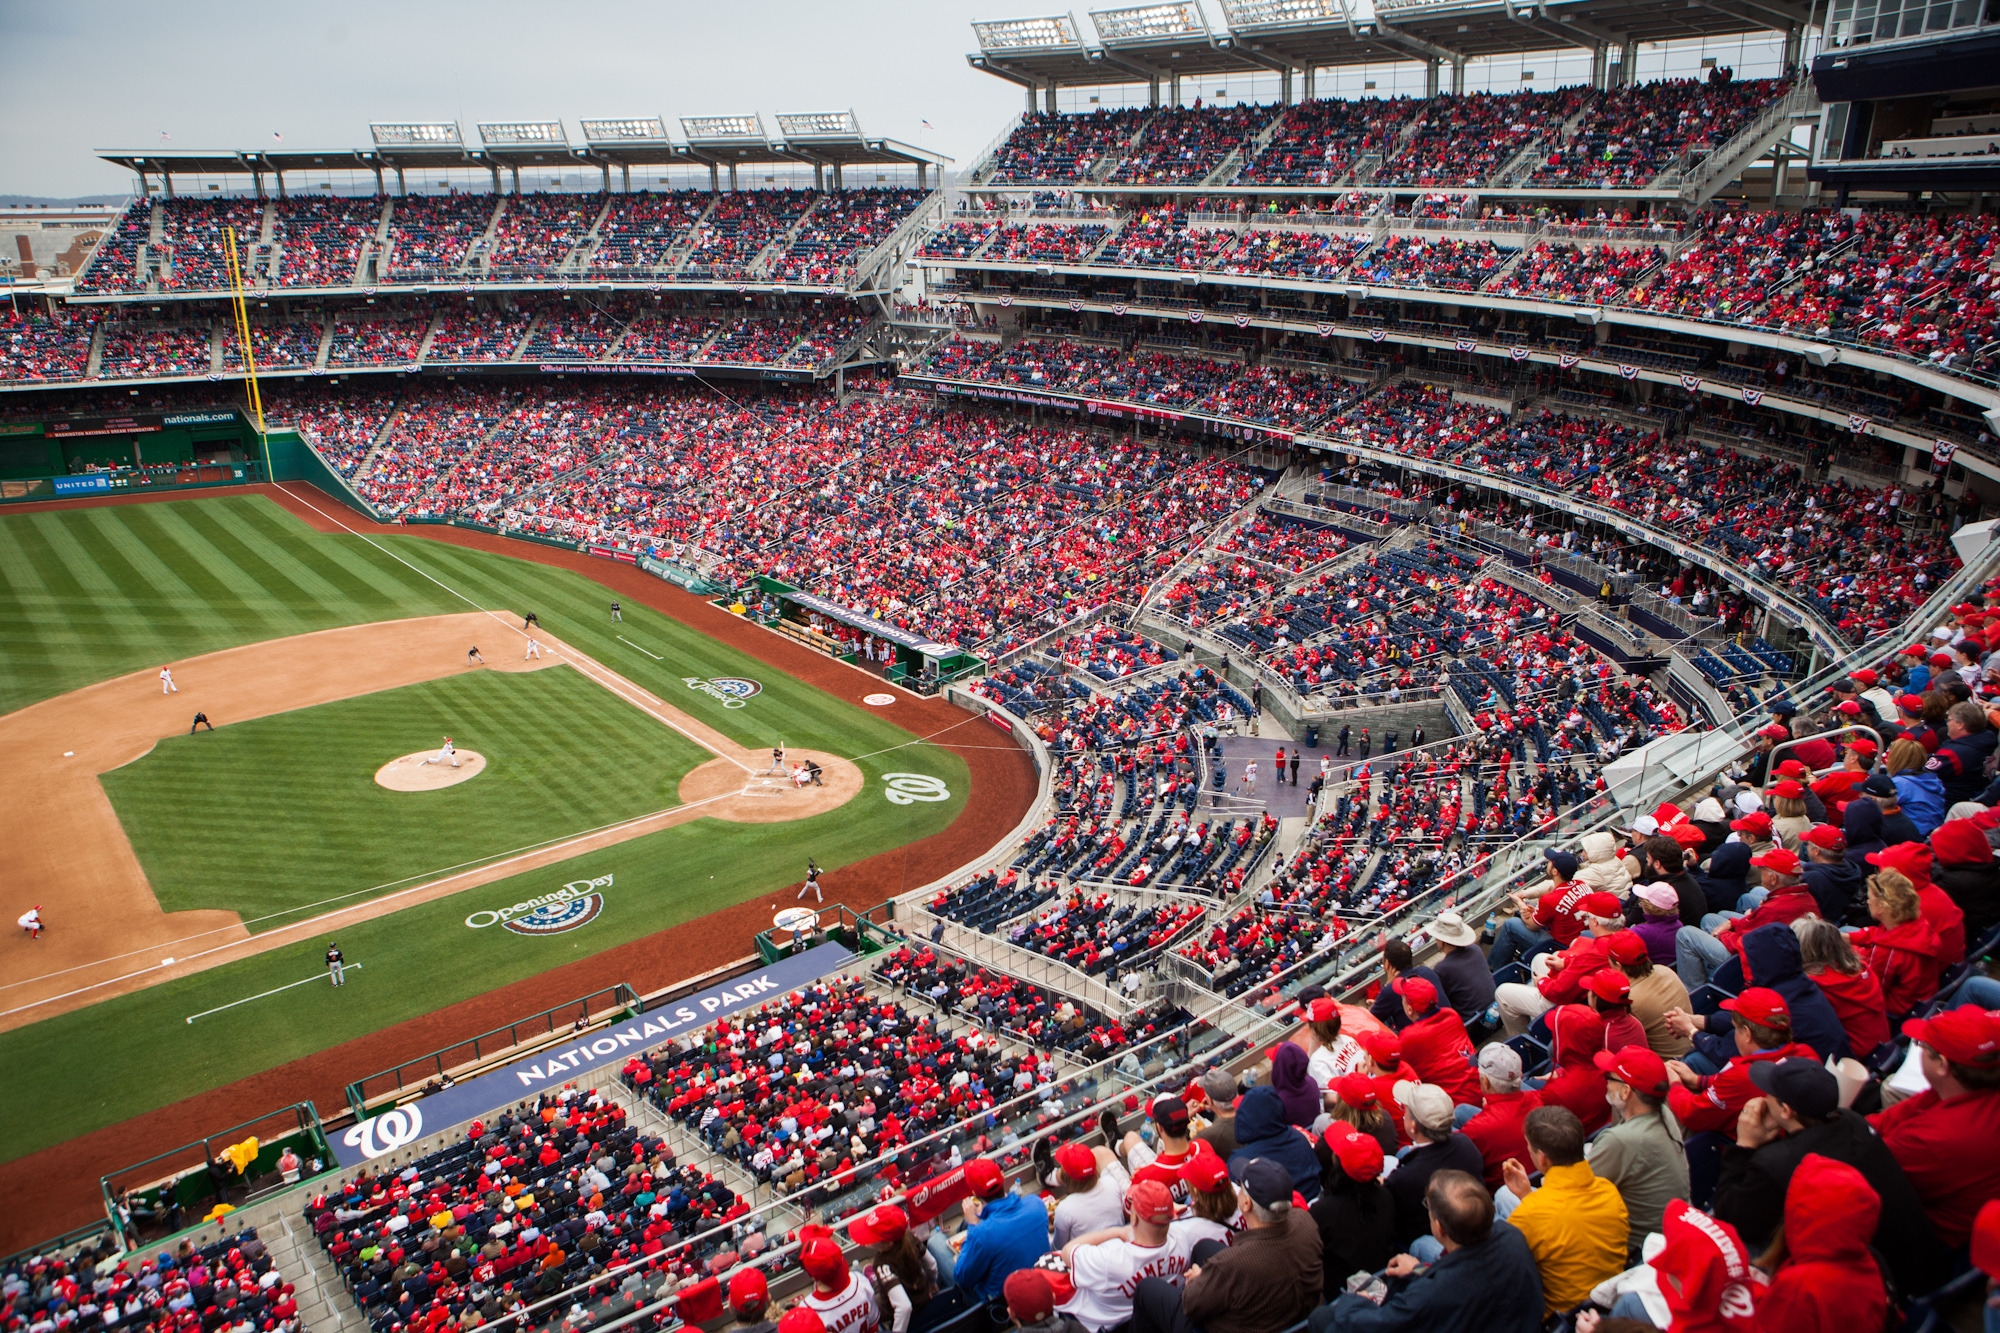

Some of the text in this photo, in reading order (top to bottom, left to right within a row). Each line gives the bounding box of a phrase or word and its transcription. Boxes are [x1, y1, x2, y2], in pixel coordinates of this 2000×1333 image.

[565, 365, 587, 373] Luxury
[588, 365, 610, 373] Vehicle
[630, 365, 666, 375] Washington
[667, 366, 695, 375] Nationals
[936, 383, 956, 394] Official
[957, 386, 977, 397] Luxury
[978, 388, 999, 399] Vehicle
[1007, 392, 1016, 401] the
[1016, 393, 1050, 406] Washington
[1051, 397, 1079, 409] Nationals
[164, 413, 234, 425] nationals.com
[1097, 407, 1123, 418] CLIPPARD
[1256, 431, 1262, 442] 2
[56, 480, 95, 489] UNITED
[1307, 440, 1328, 449] CARTER
[1340, 446, 1363, 456] DAWSON
[1401, 460, 1413, 468] BELL
[1426, 466, 1446, 476] BROWN
[1459, 474, 1482, 484] GIBSON
[1514, 489, 1540, 501] LEONARD
[1551, 499, 1570, 510] POSEY
[791, 592, 920, 645] WASHINGTON NATIONALS
[464, 873, 614, 929] Opening Day
[516, 974, 780, 1086] NATIONALS PARK
